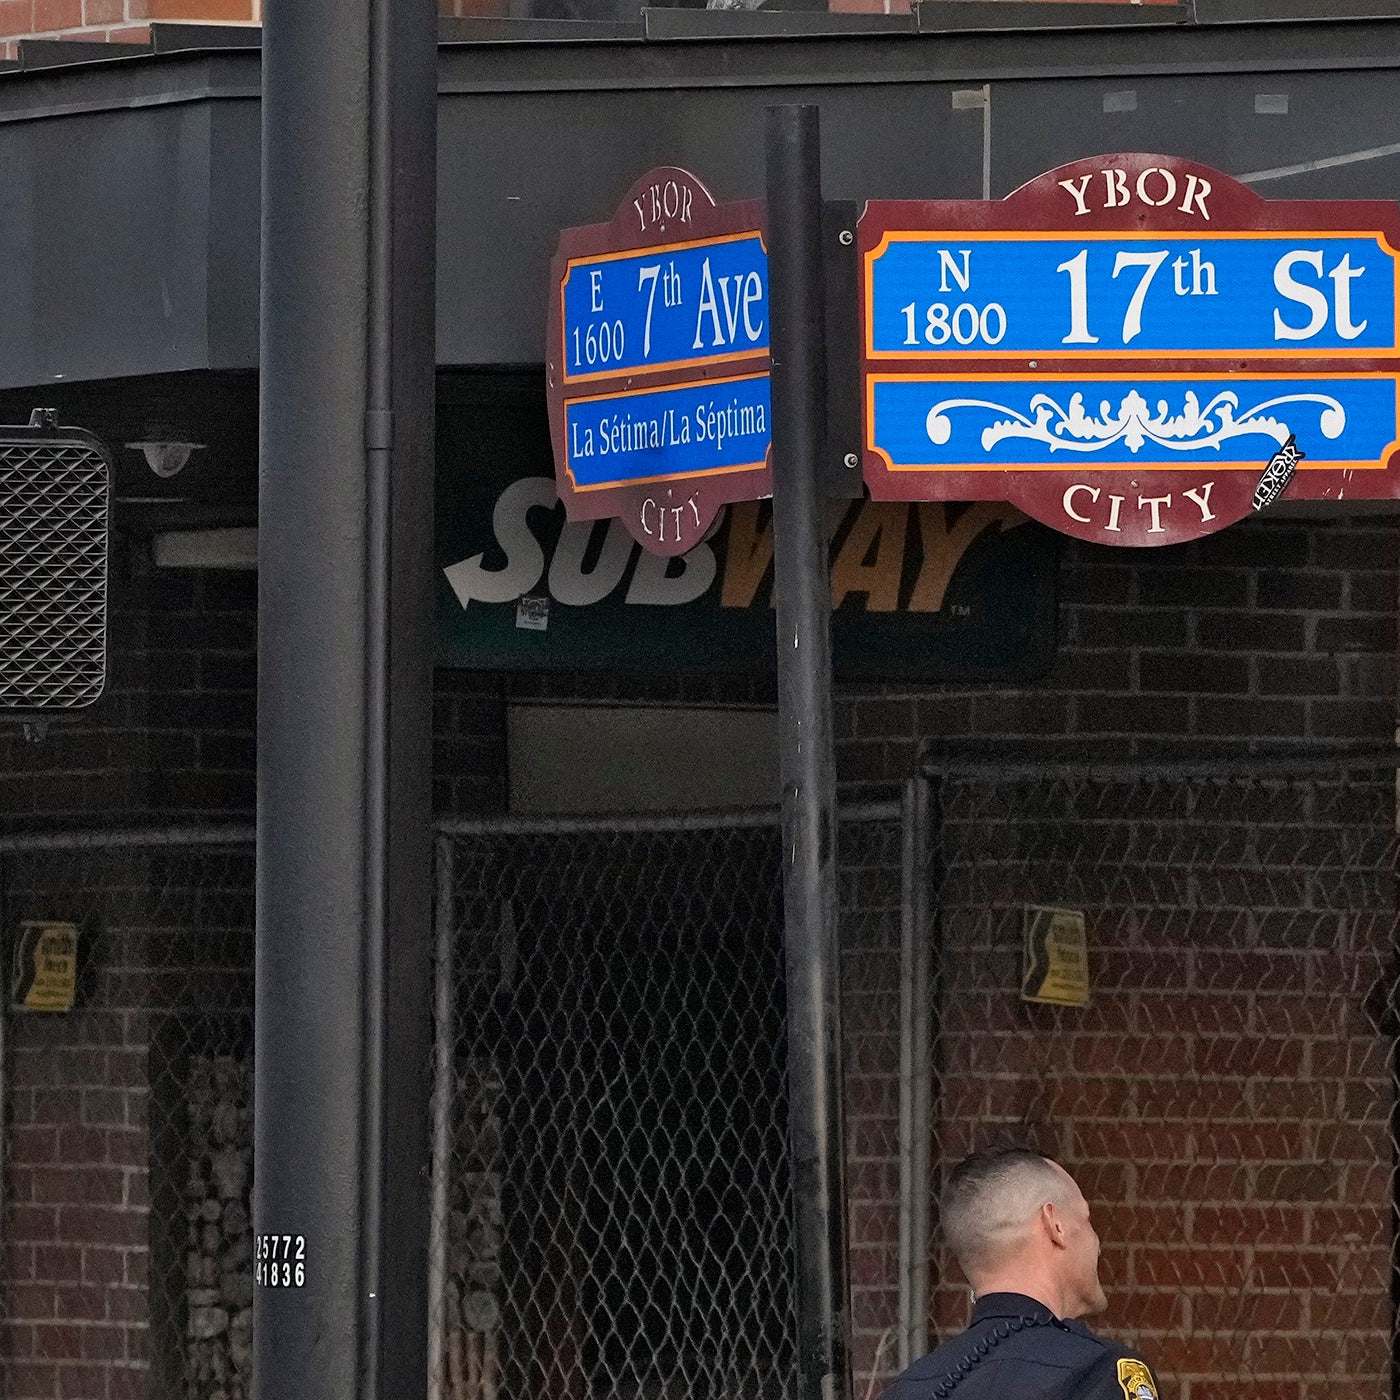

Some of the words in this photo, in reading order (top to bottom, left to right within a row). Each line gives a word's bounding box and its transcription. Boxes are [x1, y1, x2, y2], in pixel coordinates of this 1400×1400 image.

[633, 180, 693, 232] YBOR
[1058, 167, 1212, 221] YBOR
[589, 270, 604, 313] E
[936, 249, 972, 293] N
[1056, 248, 1219, 345] 17th
[1272, 249, 1368, 341] St
[637, 260, 683, 358] 7th
[692, 256, 764, 351] Ave
[900, 301, 1007, 345] 1800
[572, 319, 625, 367] 1600
[572, 422, 595, 459] La
[695, 398, 766, 450] Séptima
[639, 491, 701, 542] CITY
[1062, 481, 1216, 533] CITY
[256, 1235, 305, 1260] 25772
[255, 1262, 305, 1287] 41836
